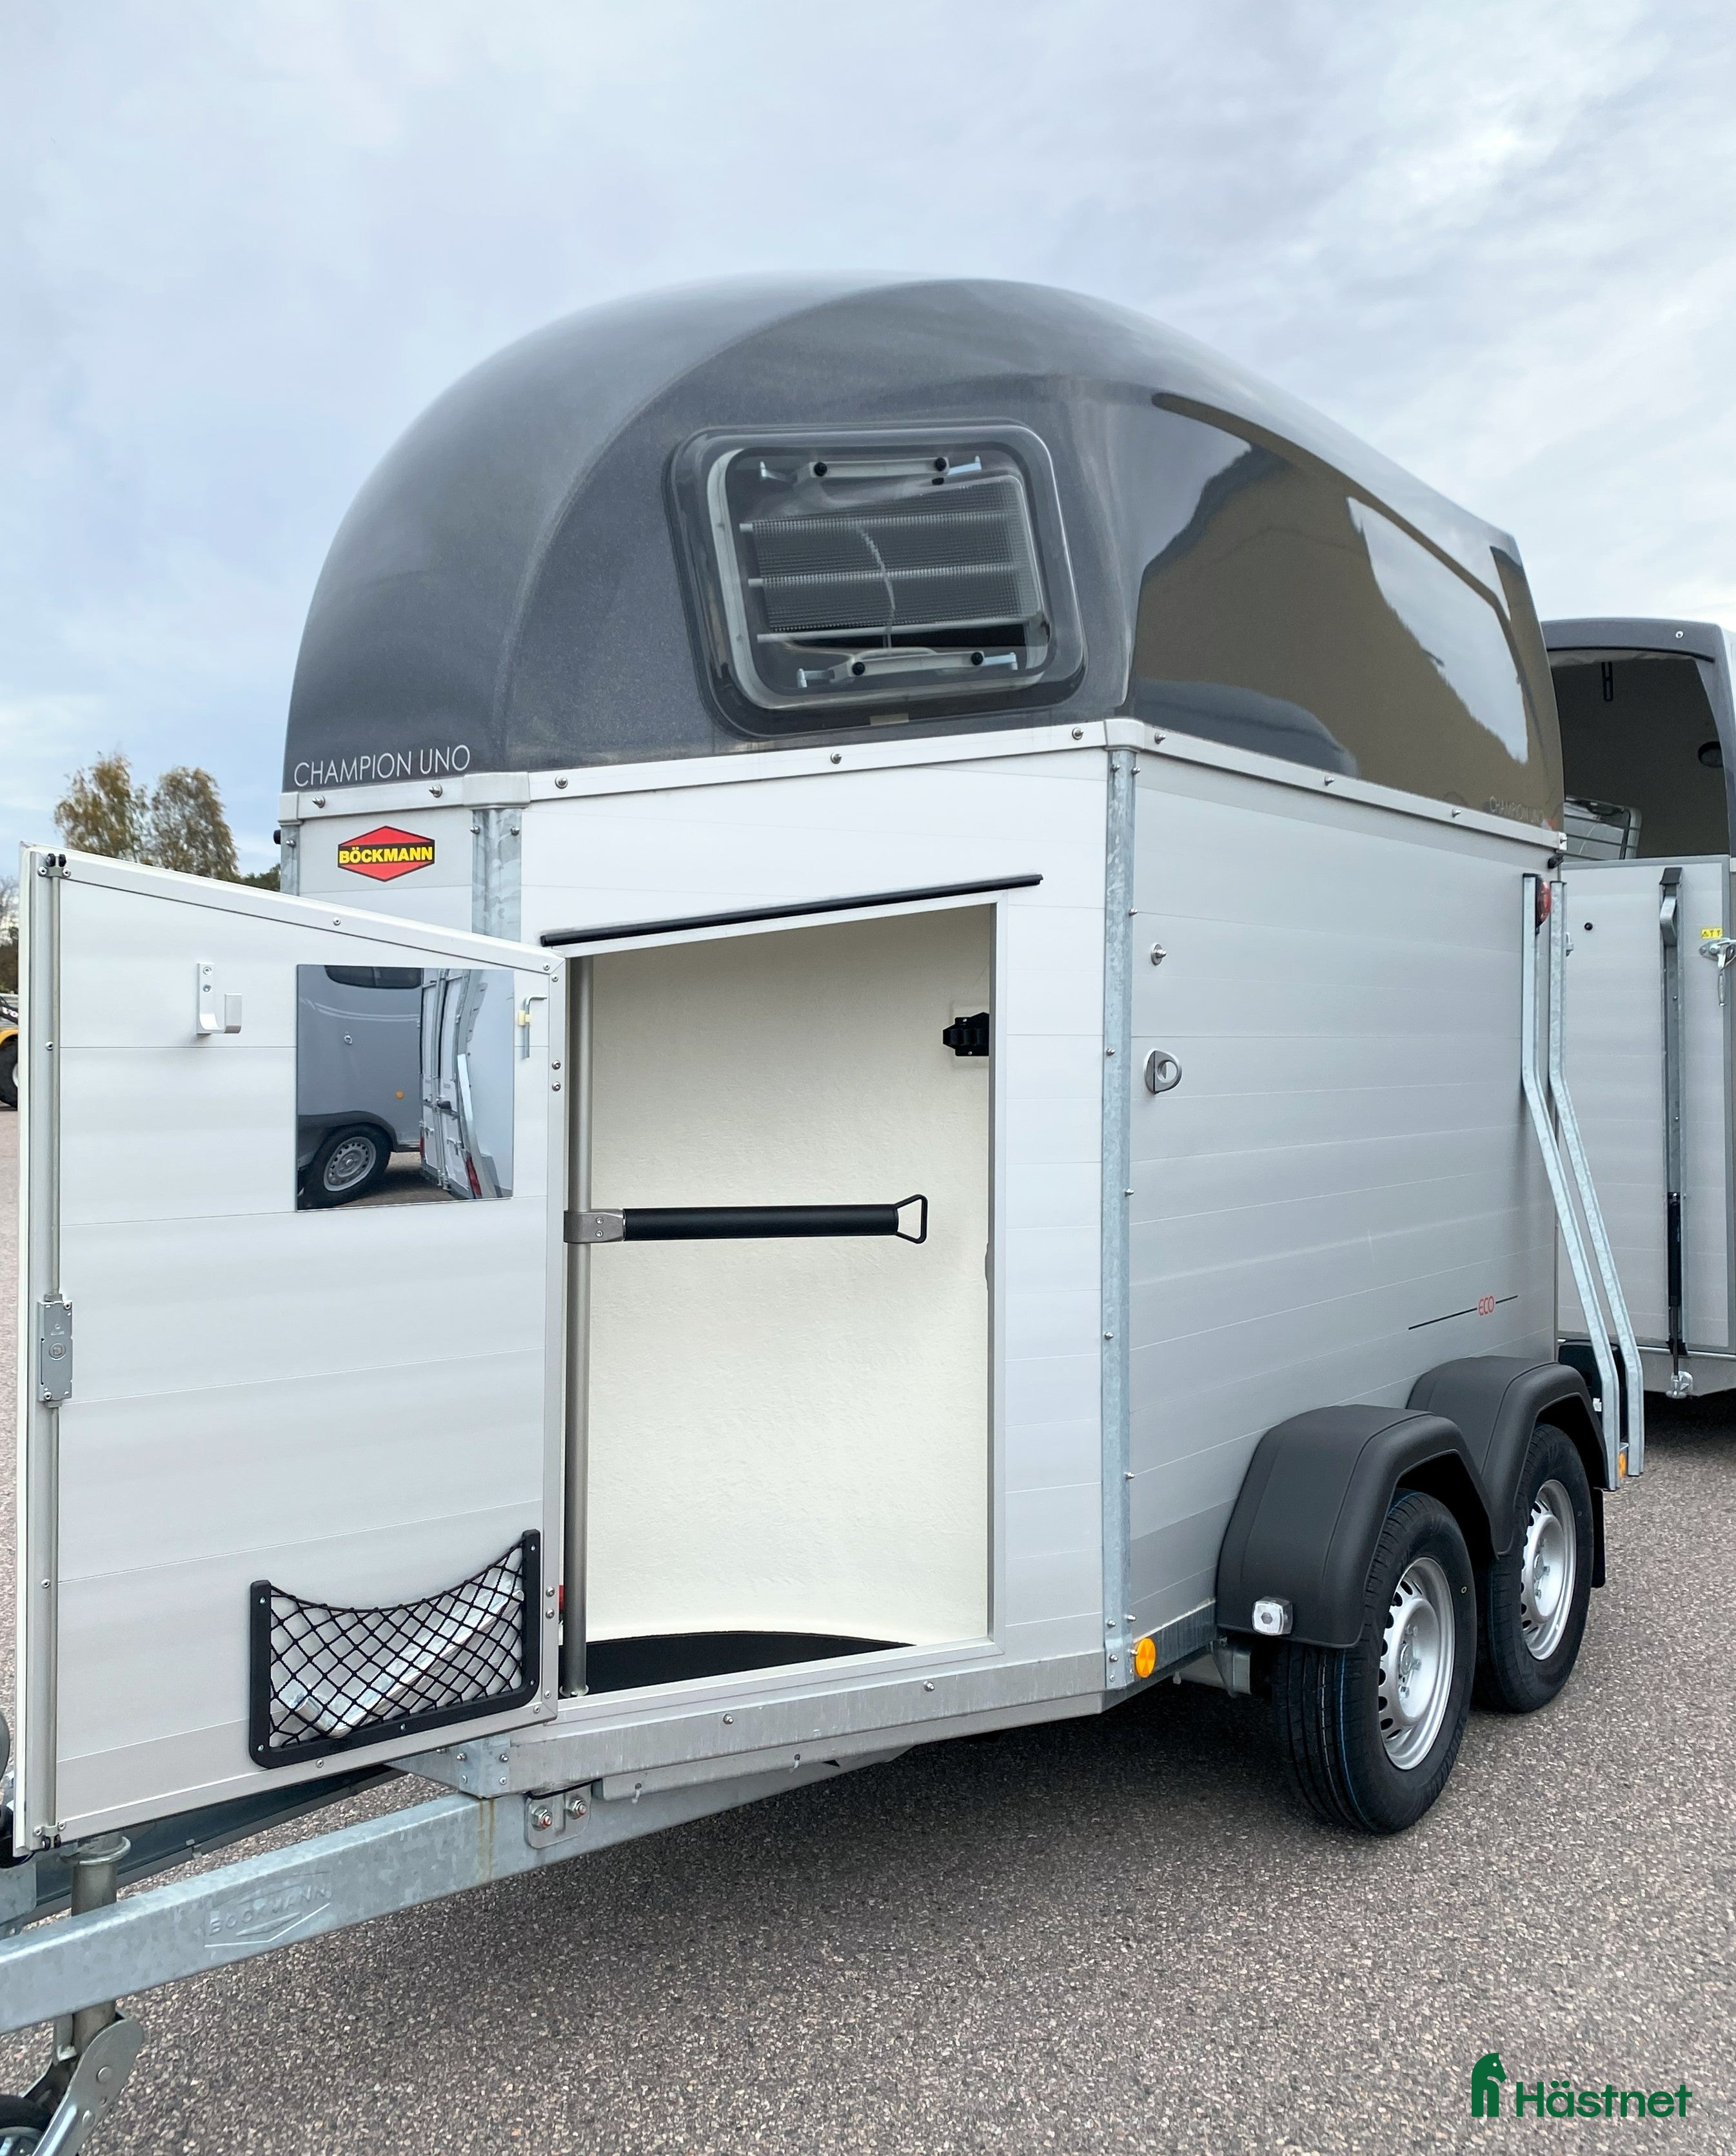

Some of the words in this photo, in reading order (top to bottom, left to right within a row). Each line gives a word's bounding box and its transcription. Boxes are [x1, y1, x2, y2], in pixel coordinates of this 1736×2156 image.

[294, 750, 412, 787] CHAMPION
[420, 744, 471, 774] UNO
[339, 847, 433, 864] BÖCKMANN
[1478, 1295, 1494, 1316] ECO
